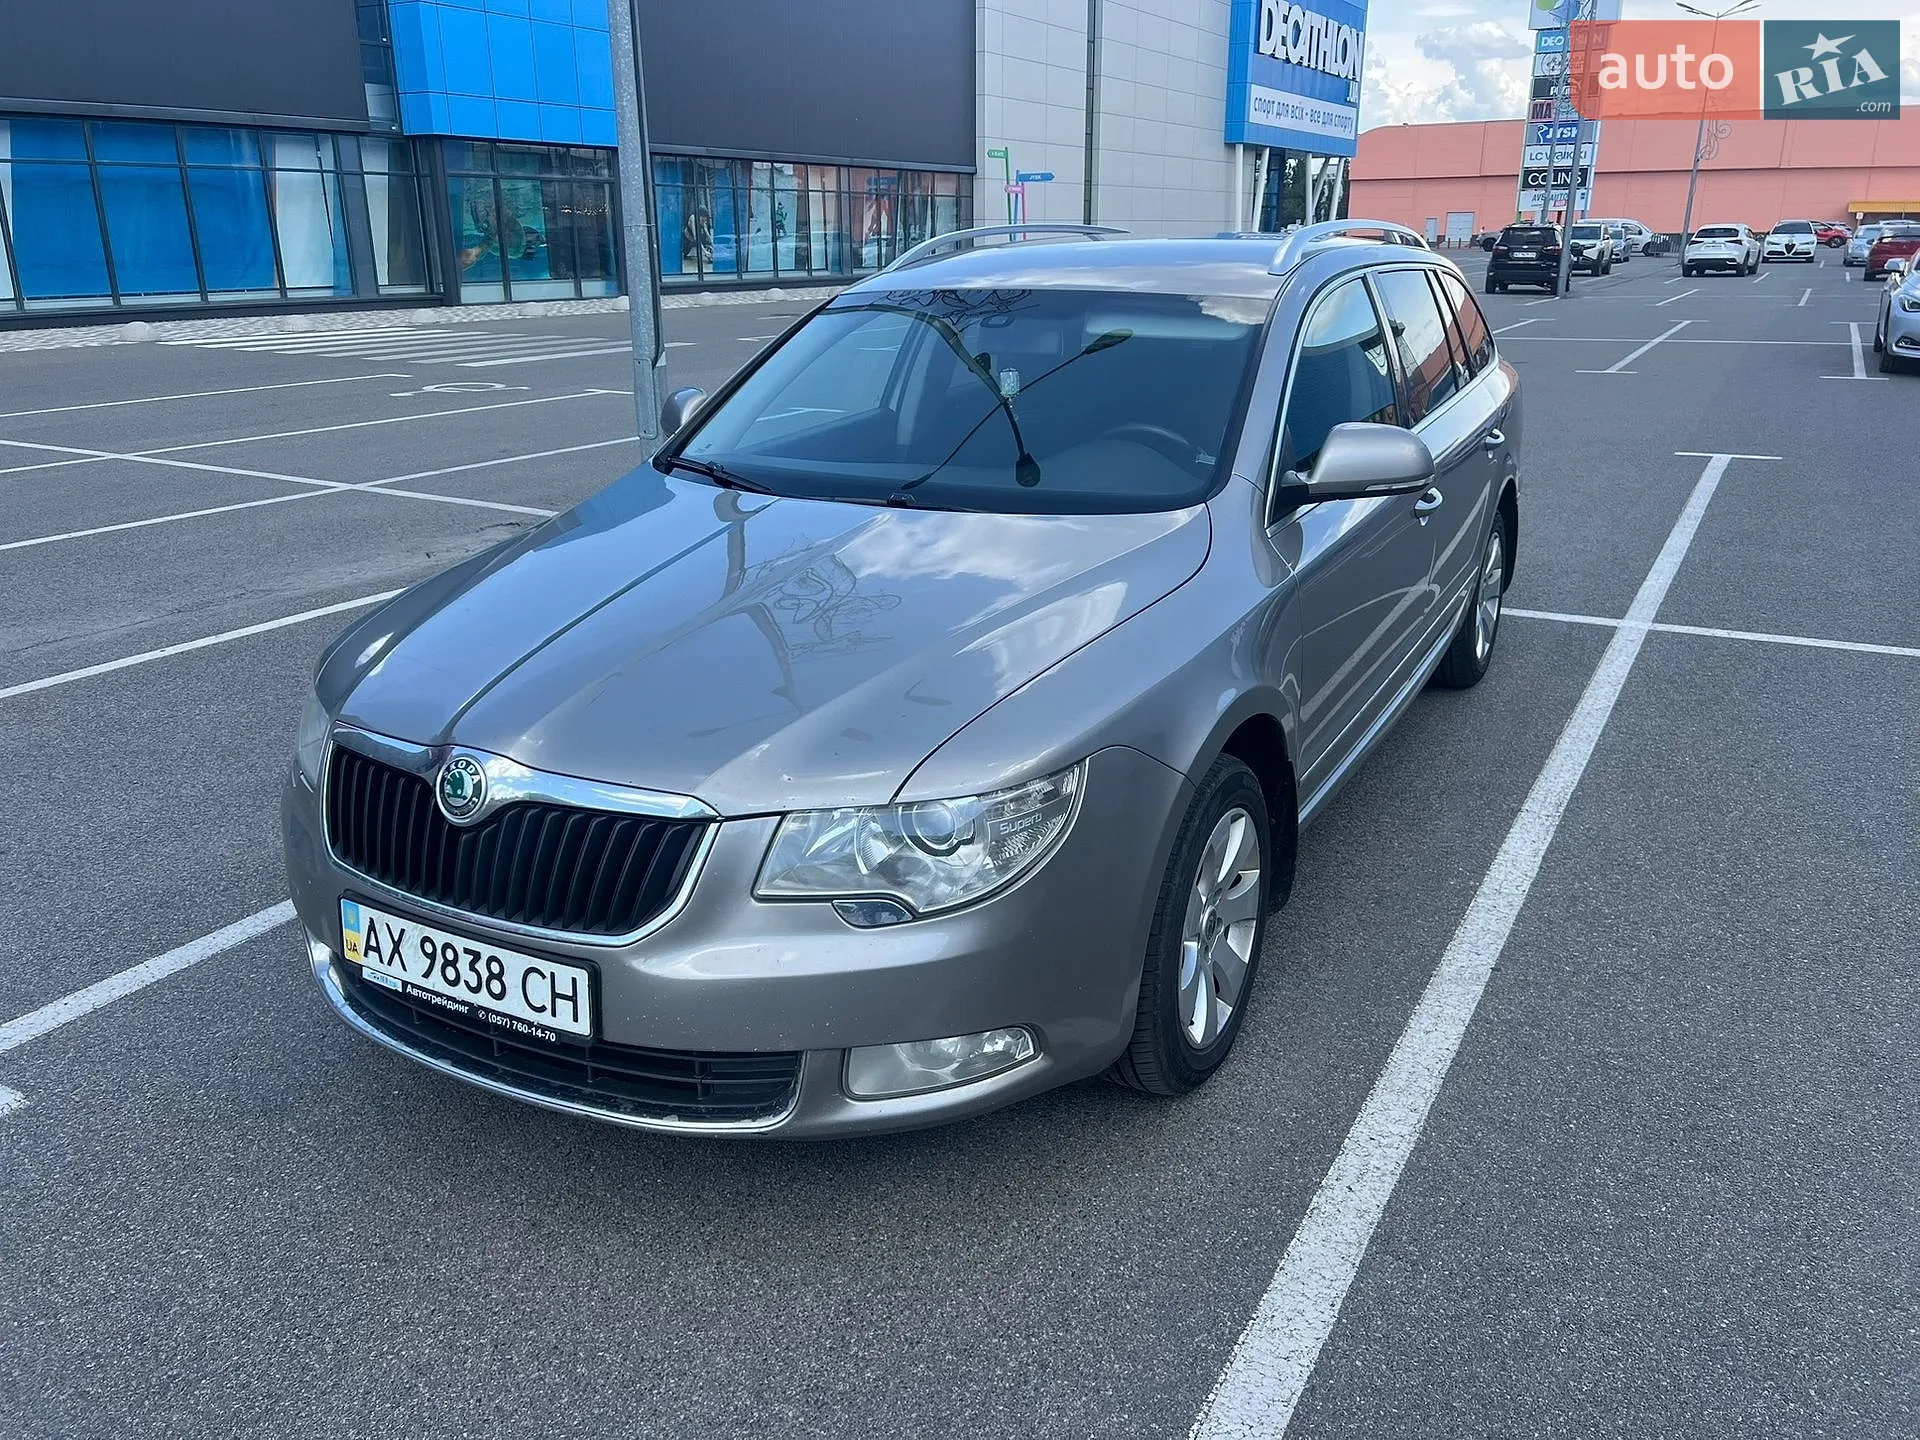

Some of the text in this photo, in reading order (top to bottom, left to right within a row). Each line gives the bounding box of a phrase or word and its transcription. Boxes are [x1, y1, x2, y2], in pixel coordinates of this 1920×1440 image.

[1259, 0, 1363, 82] DECATHLON
[1254, 97, 1275, 119] спорт
[1276, 102, 1289, 119] для
[1291, 101, 1304, 120] всіх
[1310, 109, 1320, 123] все
[1322, 111, 1333, 127] для
[1334, 113, 1353, 134] спорту
[1000, 813, 1042, 835] Superb
[346, 939, 359, 956] UA
[363, 916, 578, 1023] AX 9838 CH
[406, 983, 470, 1014] Автотрейдинг
[488, 1012, 556, 1042] (057) 760-14-70
